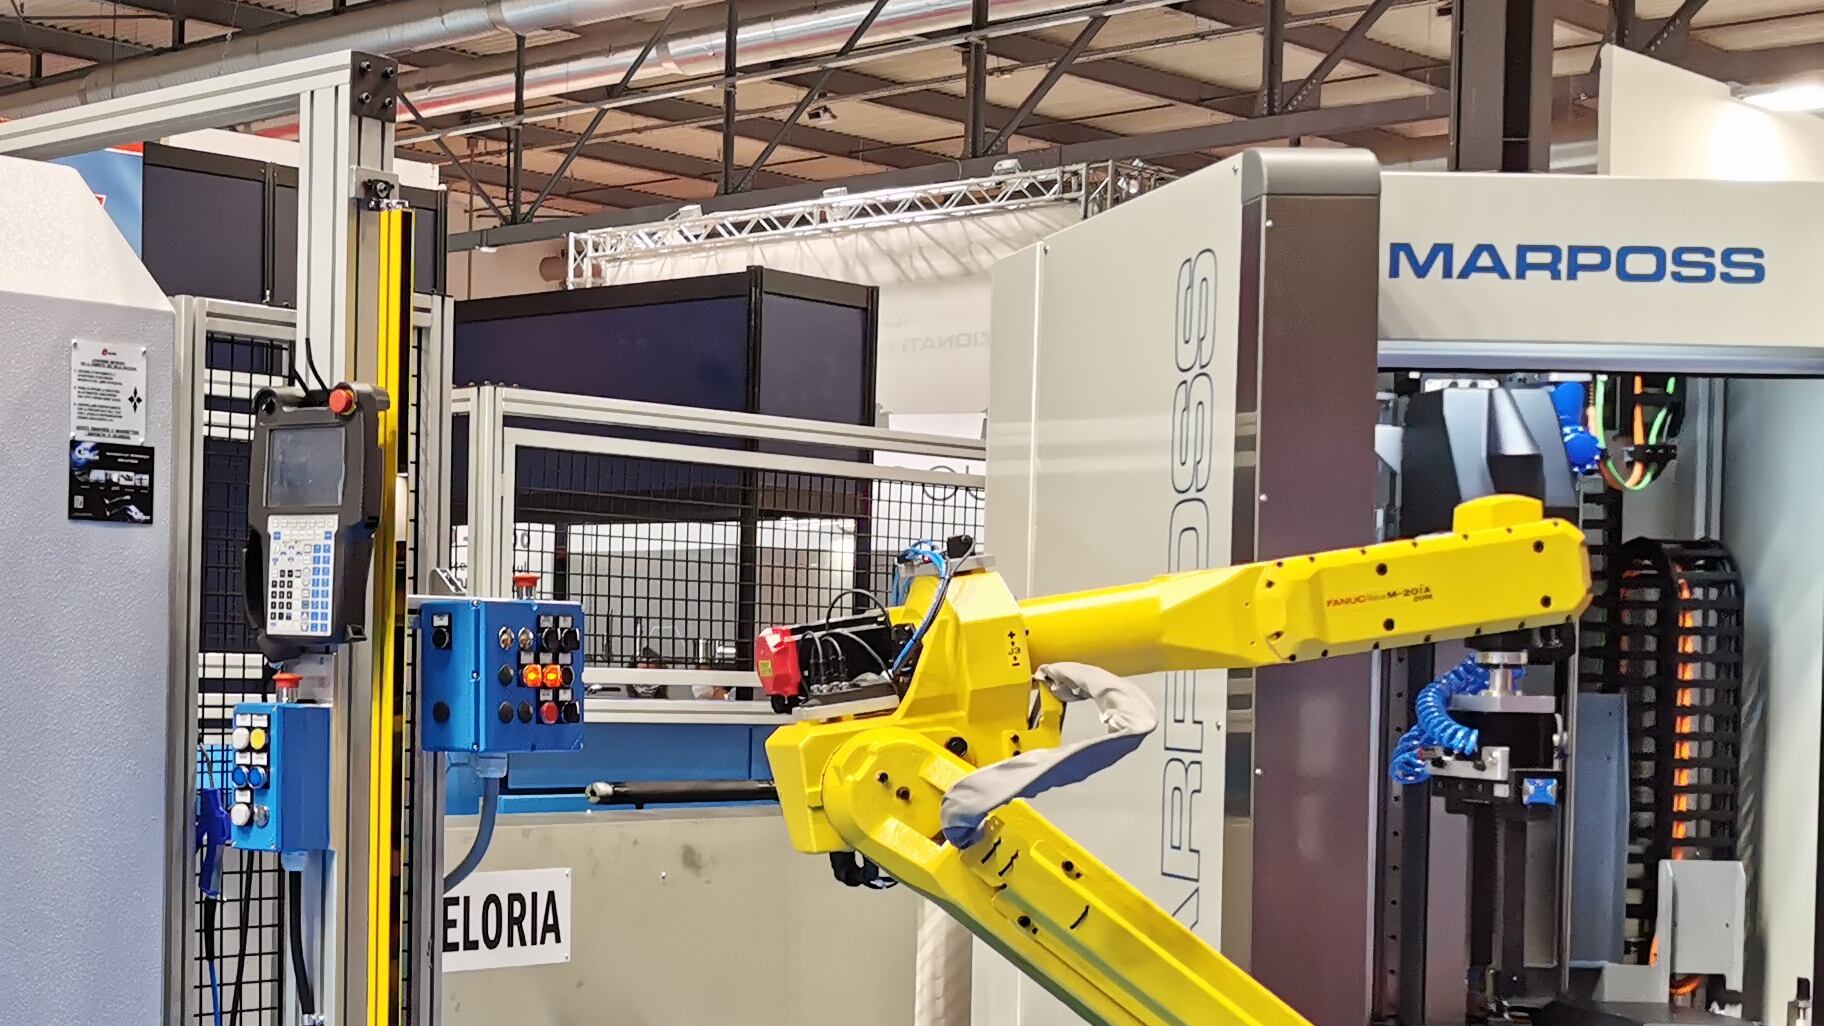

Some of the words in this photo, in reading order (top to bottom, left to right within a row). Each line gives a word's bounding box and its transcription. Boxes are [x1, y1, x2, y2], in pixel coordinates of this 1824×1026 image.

[1388, 241, 1767, 284] MARPOSS
[1326, 594, 1367, 607] FANUC
[1007, 646, 1021, 656] J3
[442, 890, 562, 953] ELORIA
